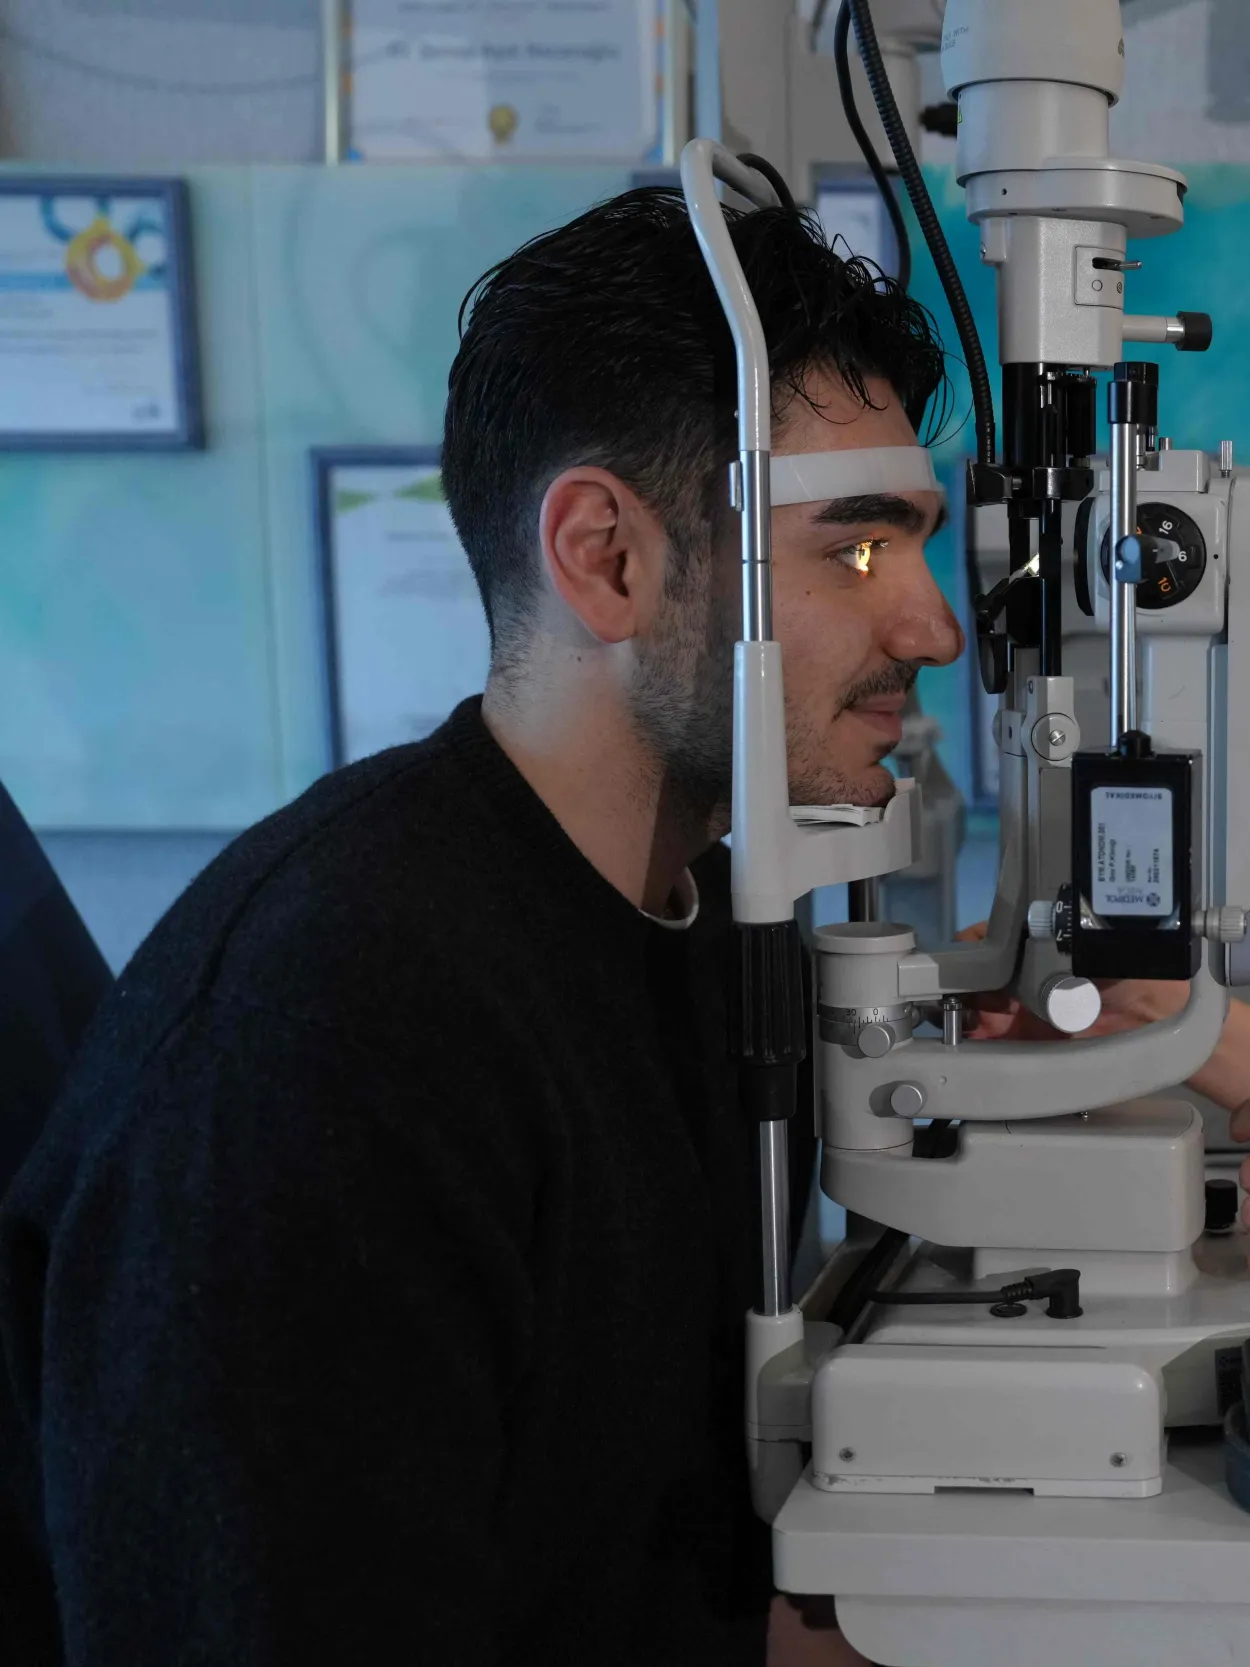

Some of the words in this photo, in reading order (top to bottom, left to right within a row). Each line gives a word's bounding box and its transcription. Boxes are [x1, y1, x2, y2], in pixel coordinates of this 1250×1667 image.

[1158, 520, 1173, 535] 16
[1178, 551, 1188, 562] 6
[873, 1008, 879, 1016] 0
